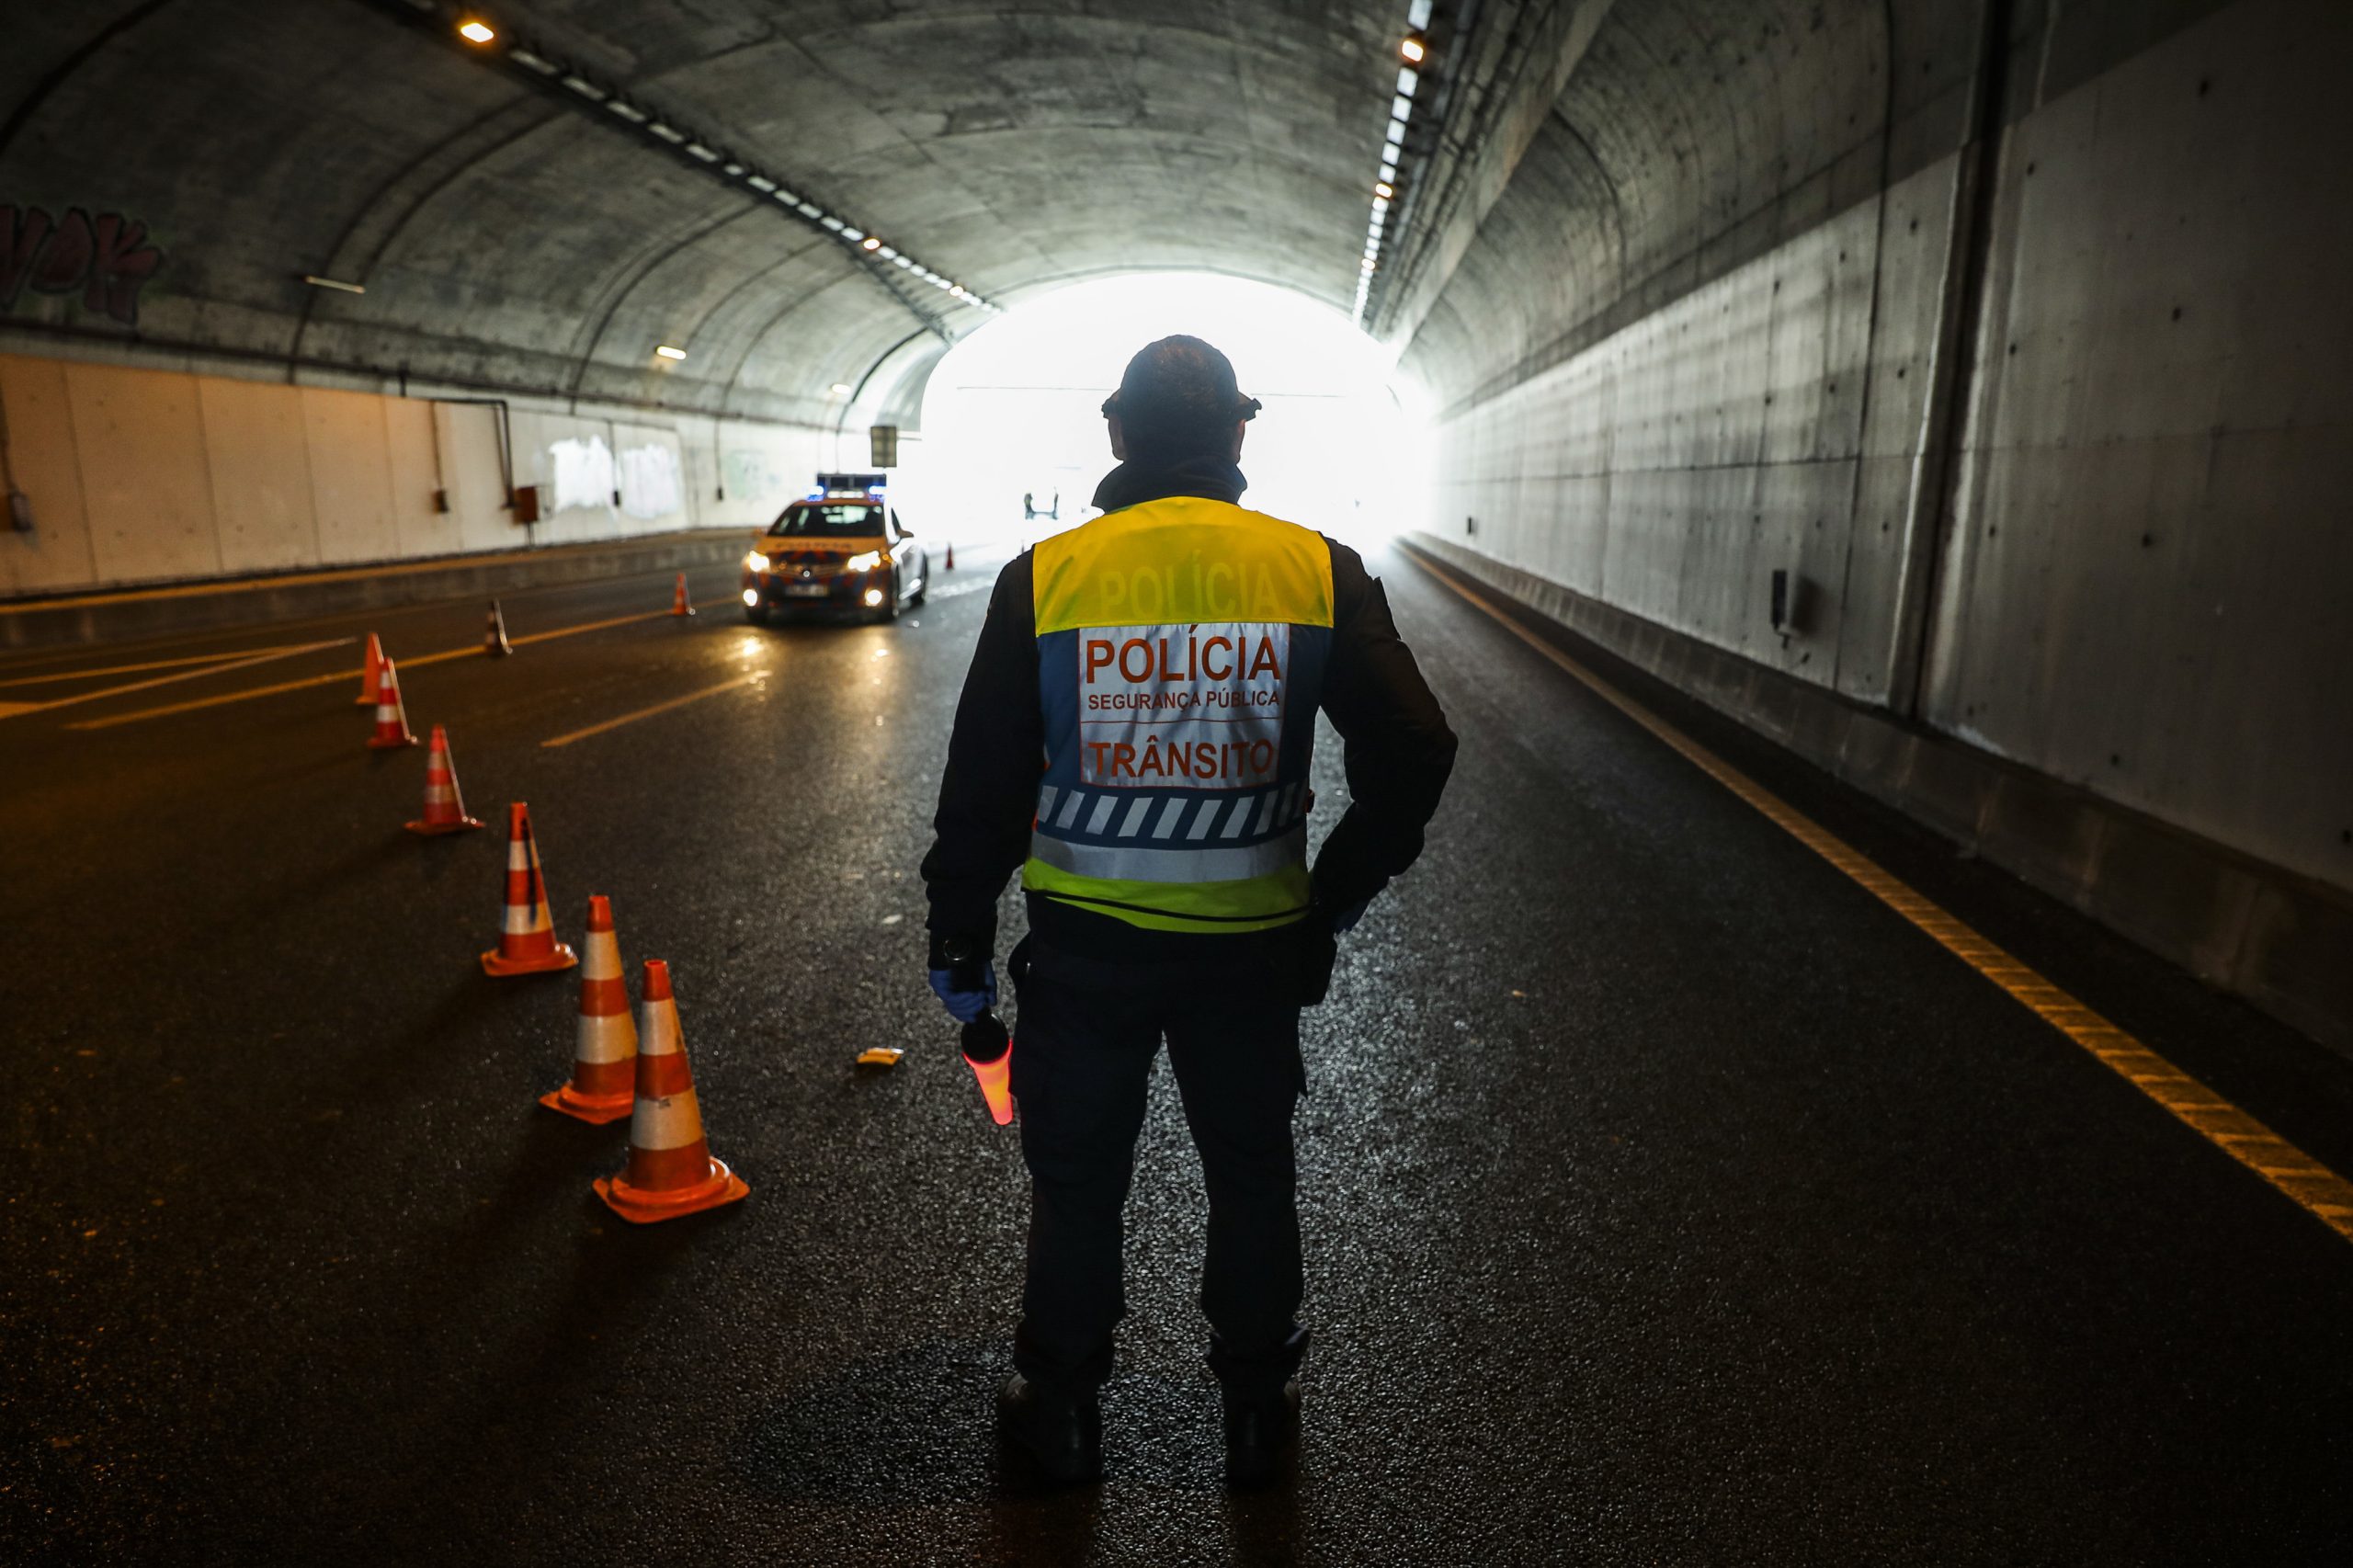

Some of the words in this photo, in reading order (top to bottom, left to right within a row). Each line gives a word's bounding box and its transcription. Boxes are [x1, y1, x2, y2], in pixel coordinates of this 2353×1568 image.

[1099, 549, 1282, 620] POLÍCIA
[1086, 624, 1281, 684] POLÍCIA
[1088, 691, 1201, 712] SEGURANÇA
[1205, 687, 1280, 709] PÚBLICA
[1087, 734, 1275, 779] TRÂNSITO
